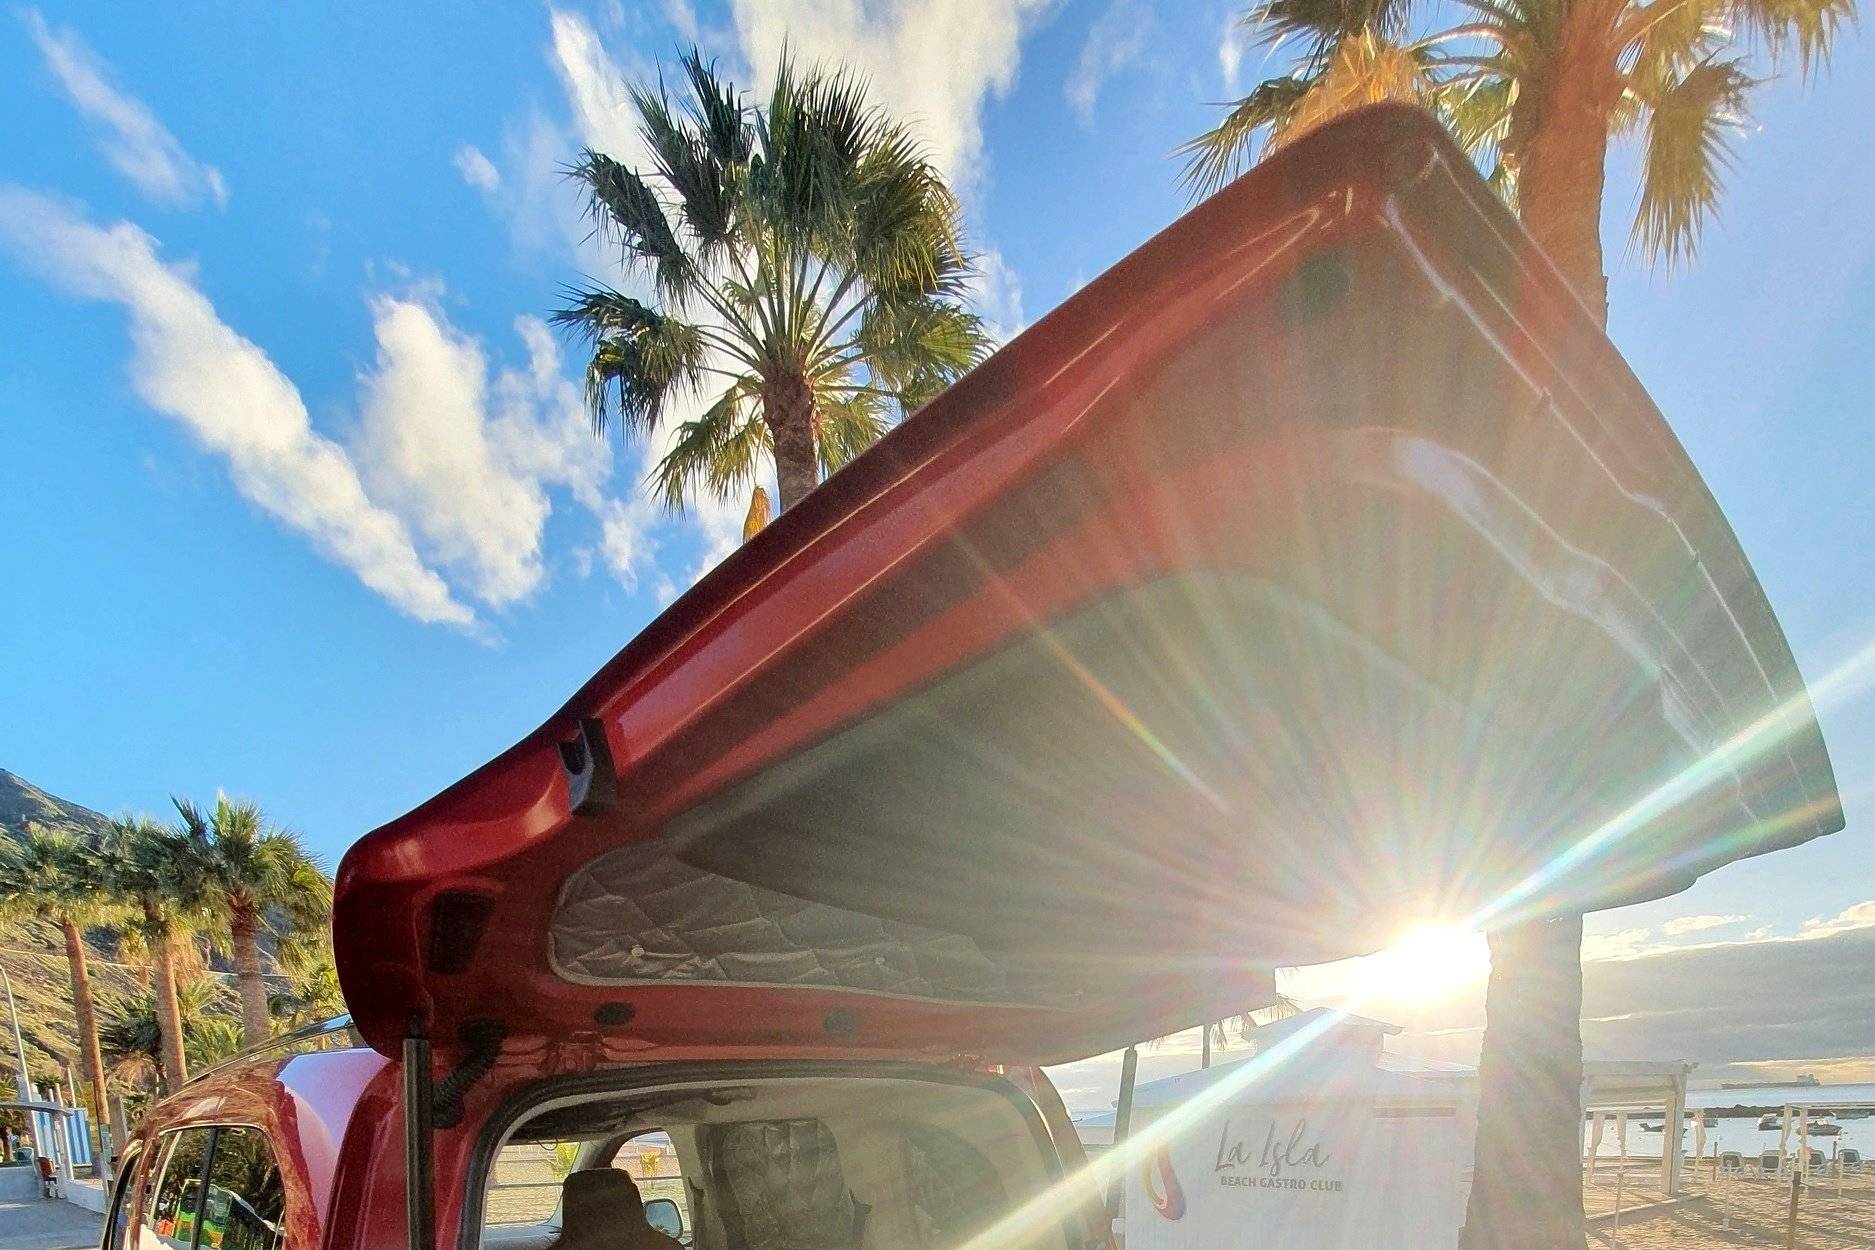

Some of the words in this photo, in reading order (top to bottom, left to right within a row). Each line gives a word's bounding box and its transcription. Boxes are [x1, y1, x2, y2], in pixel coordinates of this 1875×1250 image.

[1214, 1119, 1251, 1172] La
[1259, 1118, 1331, 1176] Isla
[1220, 1175, 1256, 1188] BEACH
[1259, 1177, 1306, 1190] GASTRO
[1310, 1180, 1343, 1192] CLUB
